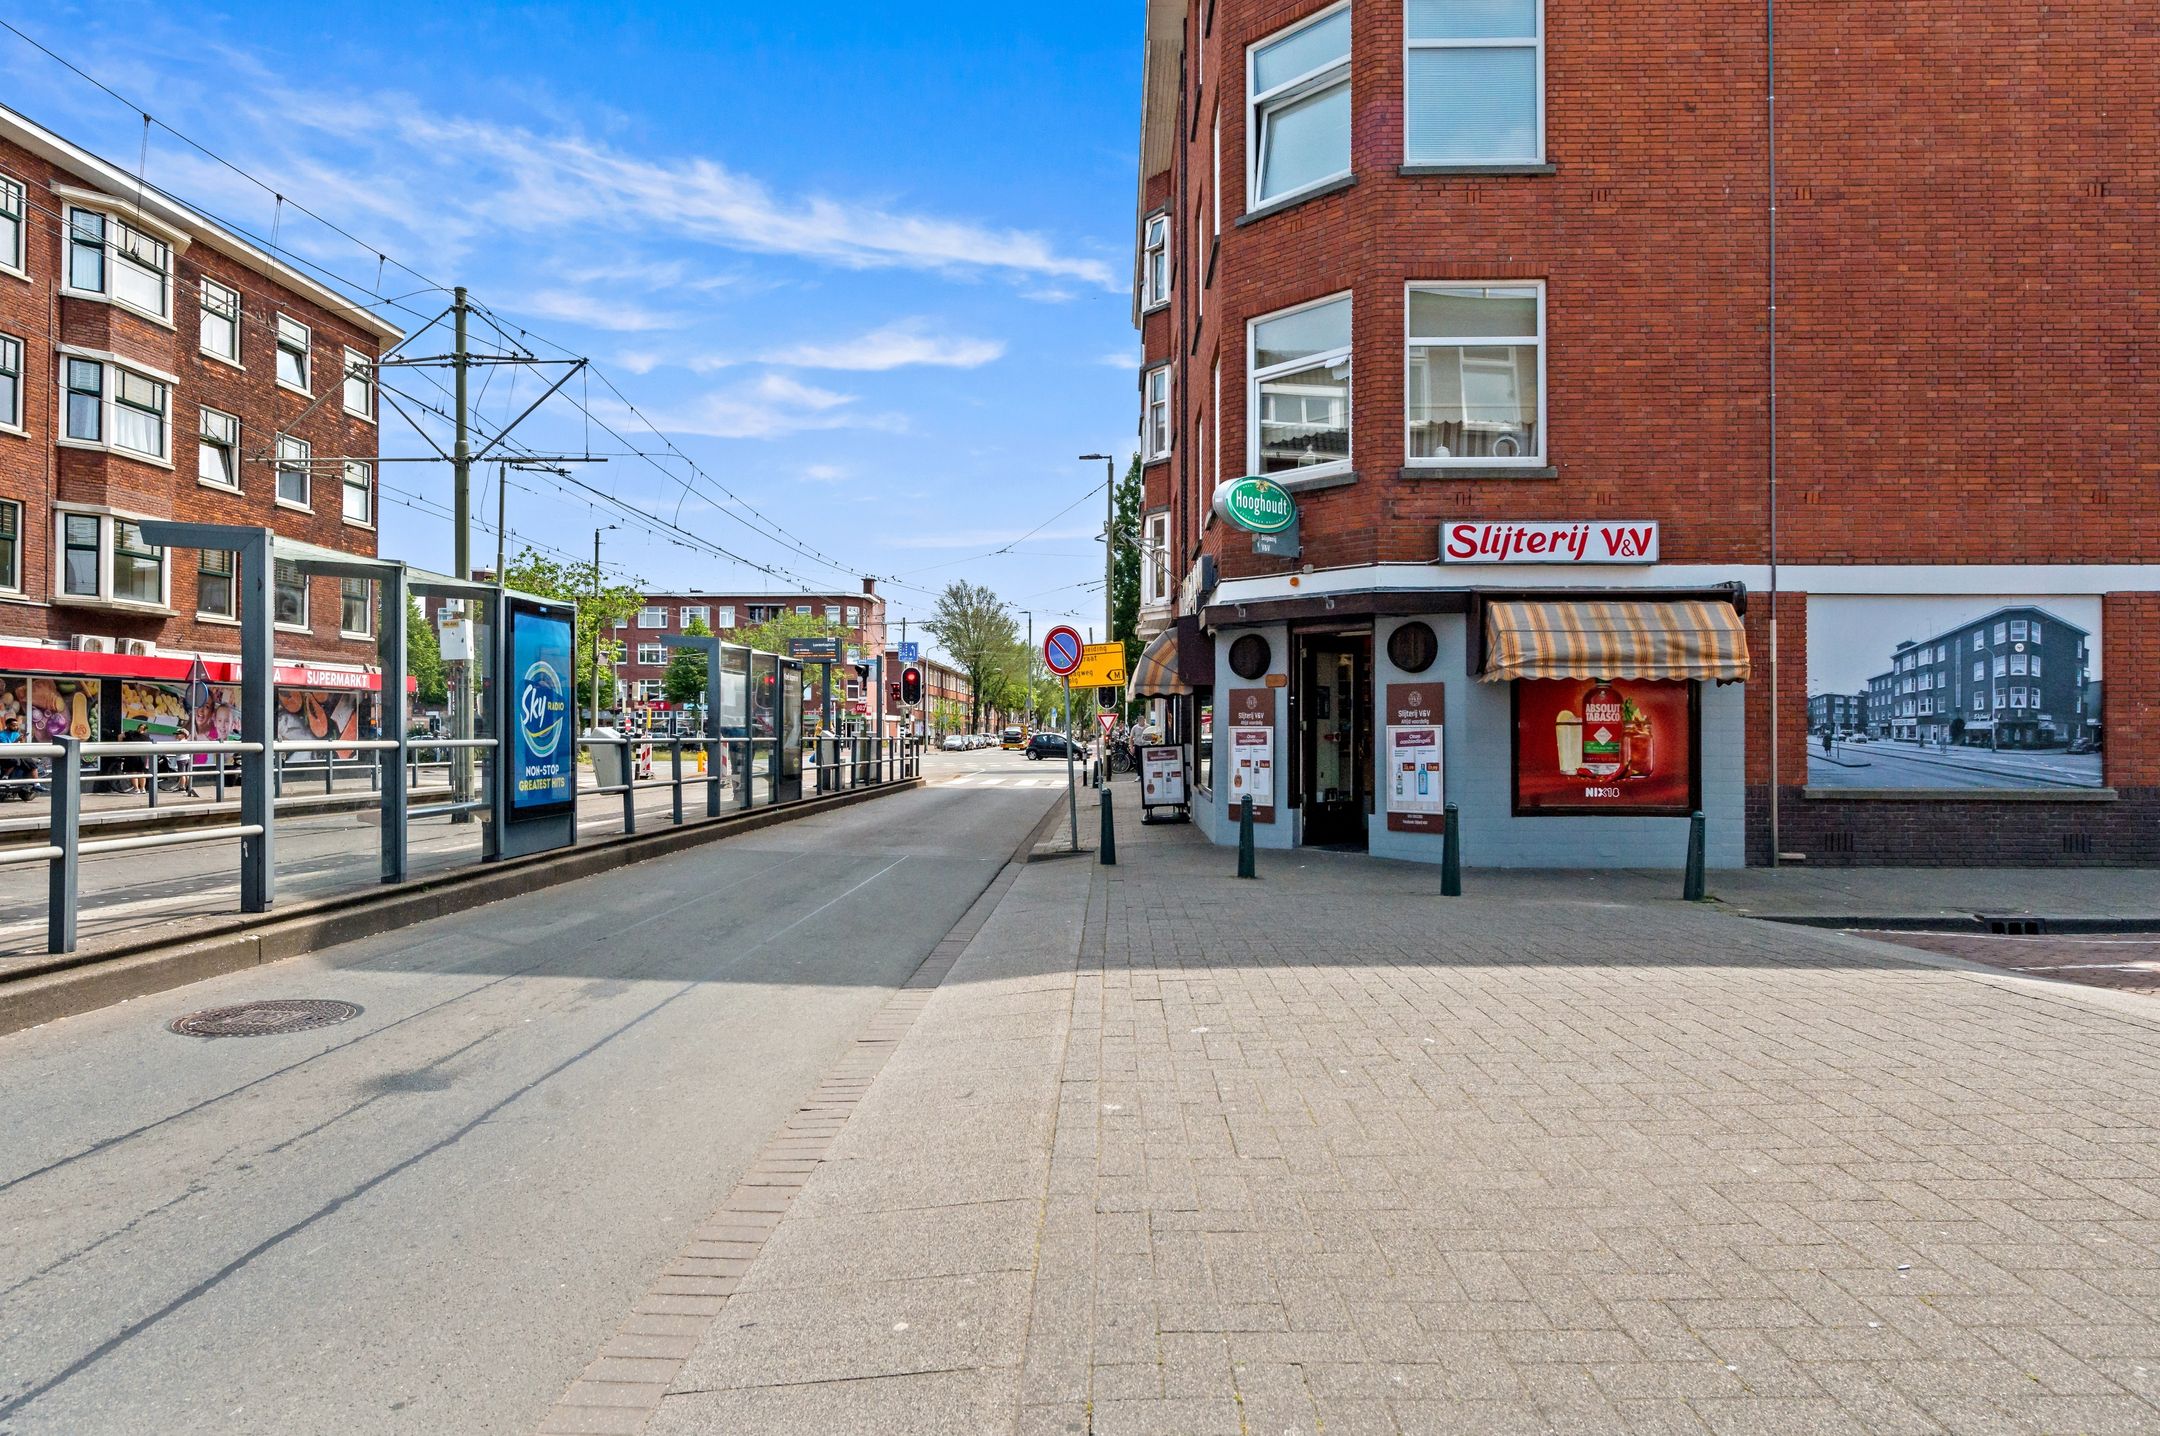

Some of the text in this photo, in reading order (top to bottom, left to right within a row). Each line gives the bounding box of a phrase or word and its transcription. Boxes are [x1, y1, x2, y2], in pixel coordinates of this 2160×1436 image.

[1235, 489, 1288, 516] Hooghoudt
[1447, 524, 1653, 561] Slijterij V&V
[307, 671, 369, 687] SUPERMARKT
[522, 684, 564, 728] Sky RADIO
[1585, 703, 1620, 713] ABSOLUT
[1585, 713, 1620, 722] TABASCO
[525, 764, 560, 777] NON-STOP
[518, 777, 565, 791] GREATEST HITS
